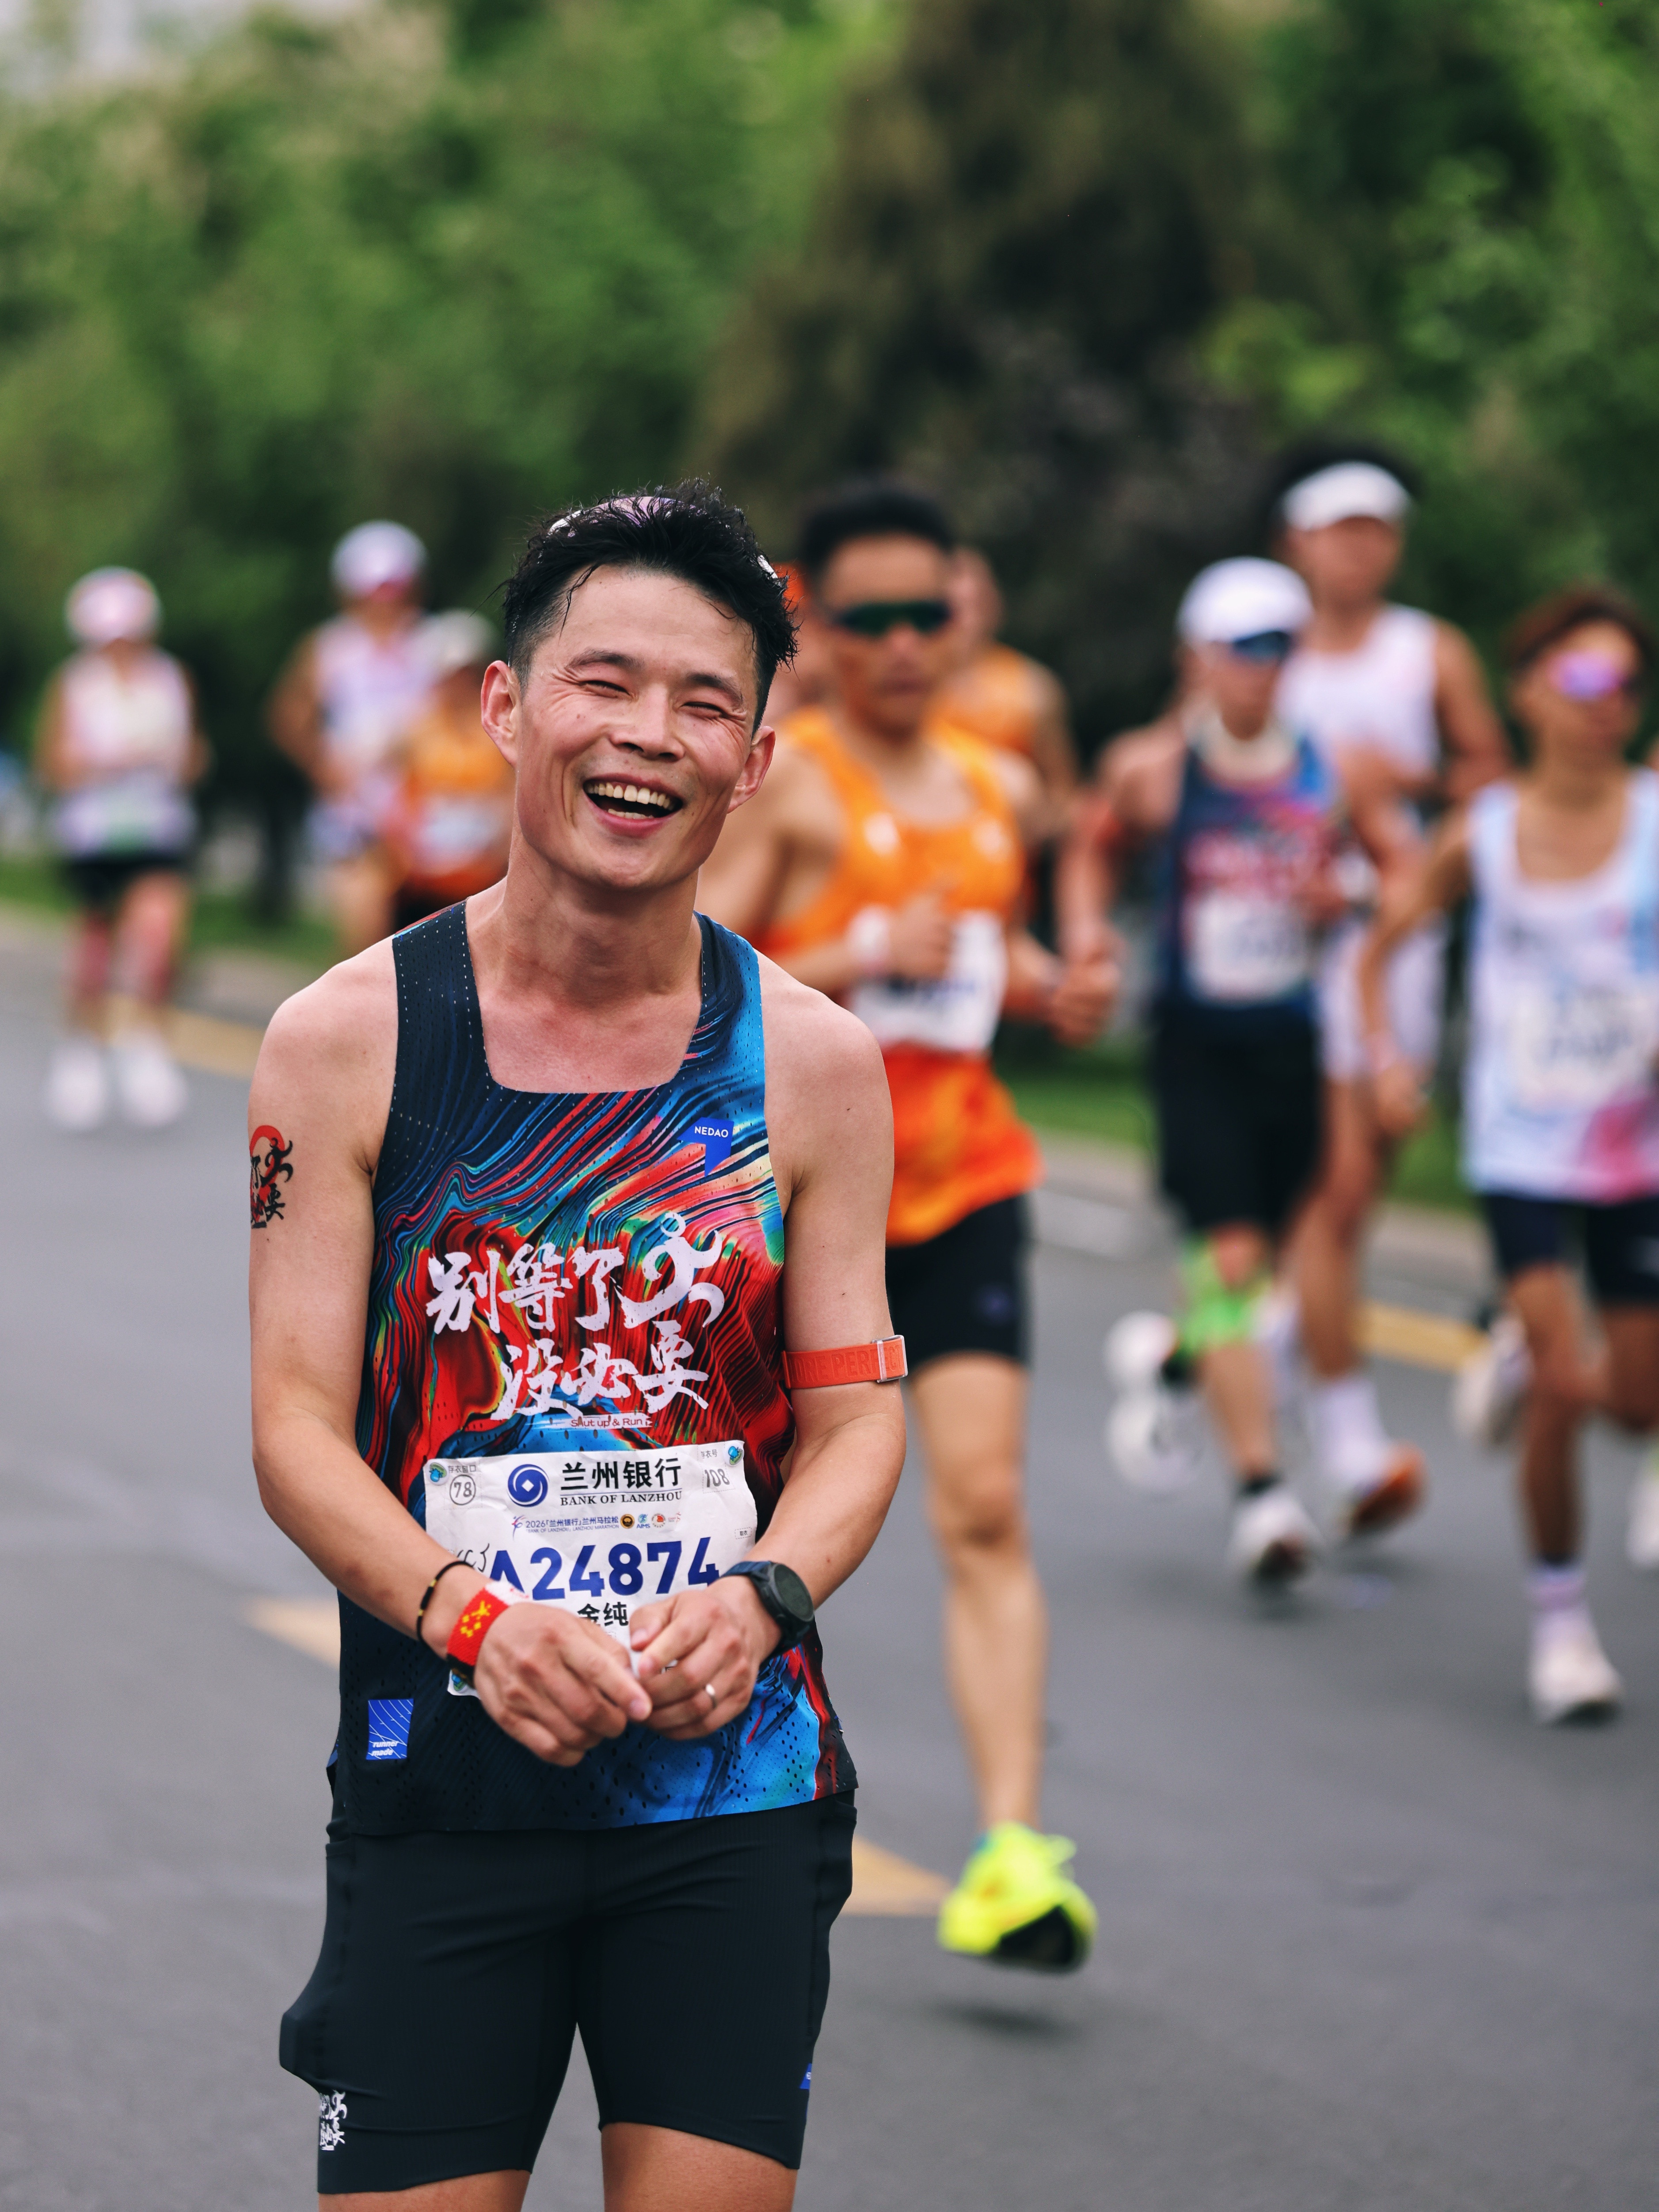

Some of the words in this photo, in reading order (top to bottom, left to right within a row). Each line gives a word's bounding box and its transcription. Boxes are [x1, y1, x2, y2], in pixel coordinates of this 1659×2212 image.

[694, 1126, 729, 1138] NEDAO
[426, 1242, 624, 1335] 别等了
[490, 1320, 709, 1421] 没必要
[622, 1417, 643, 1426] Run
[560, 1458, 681, 1491] 兰州银行
[704, 1468, 730, 1488] 108
[453, 1481, 472, 1498] 78
[560, 1496, 597, 1506] BANK
[600, 1494, 617, 1504] OF
[621, 1491, 682, 1503] LANZHOU
[489, 1537, 720, 1601] A24874
[371, 1748, 394, 1756] made
